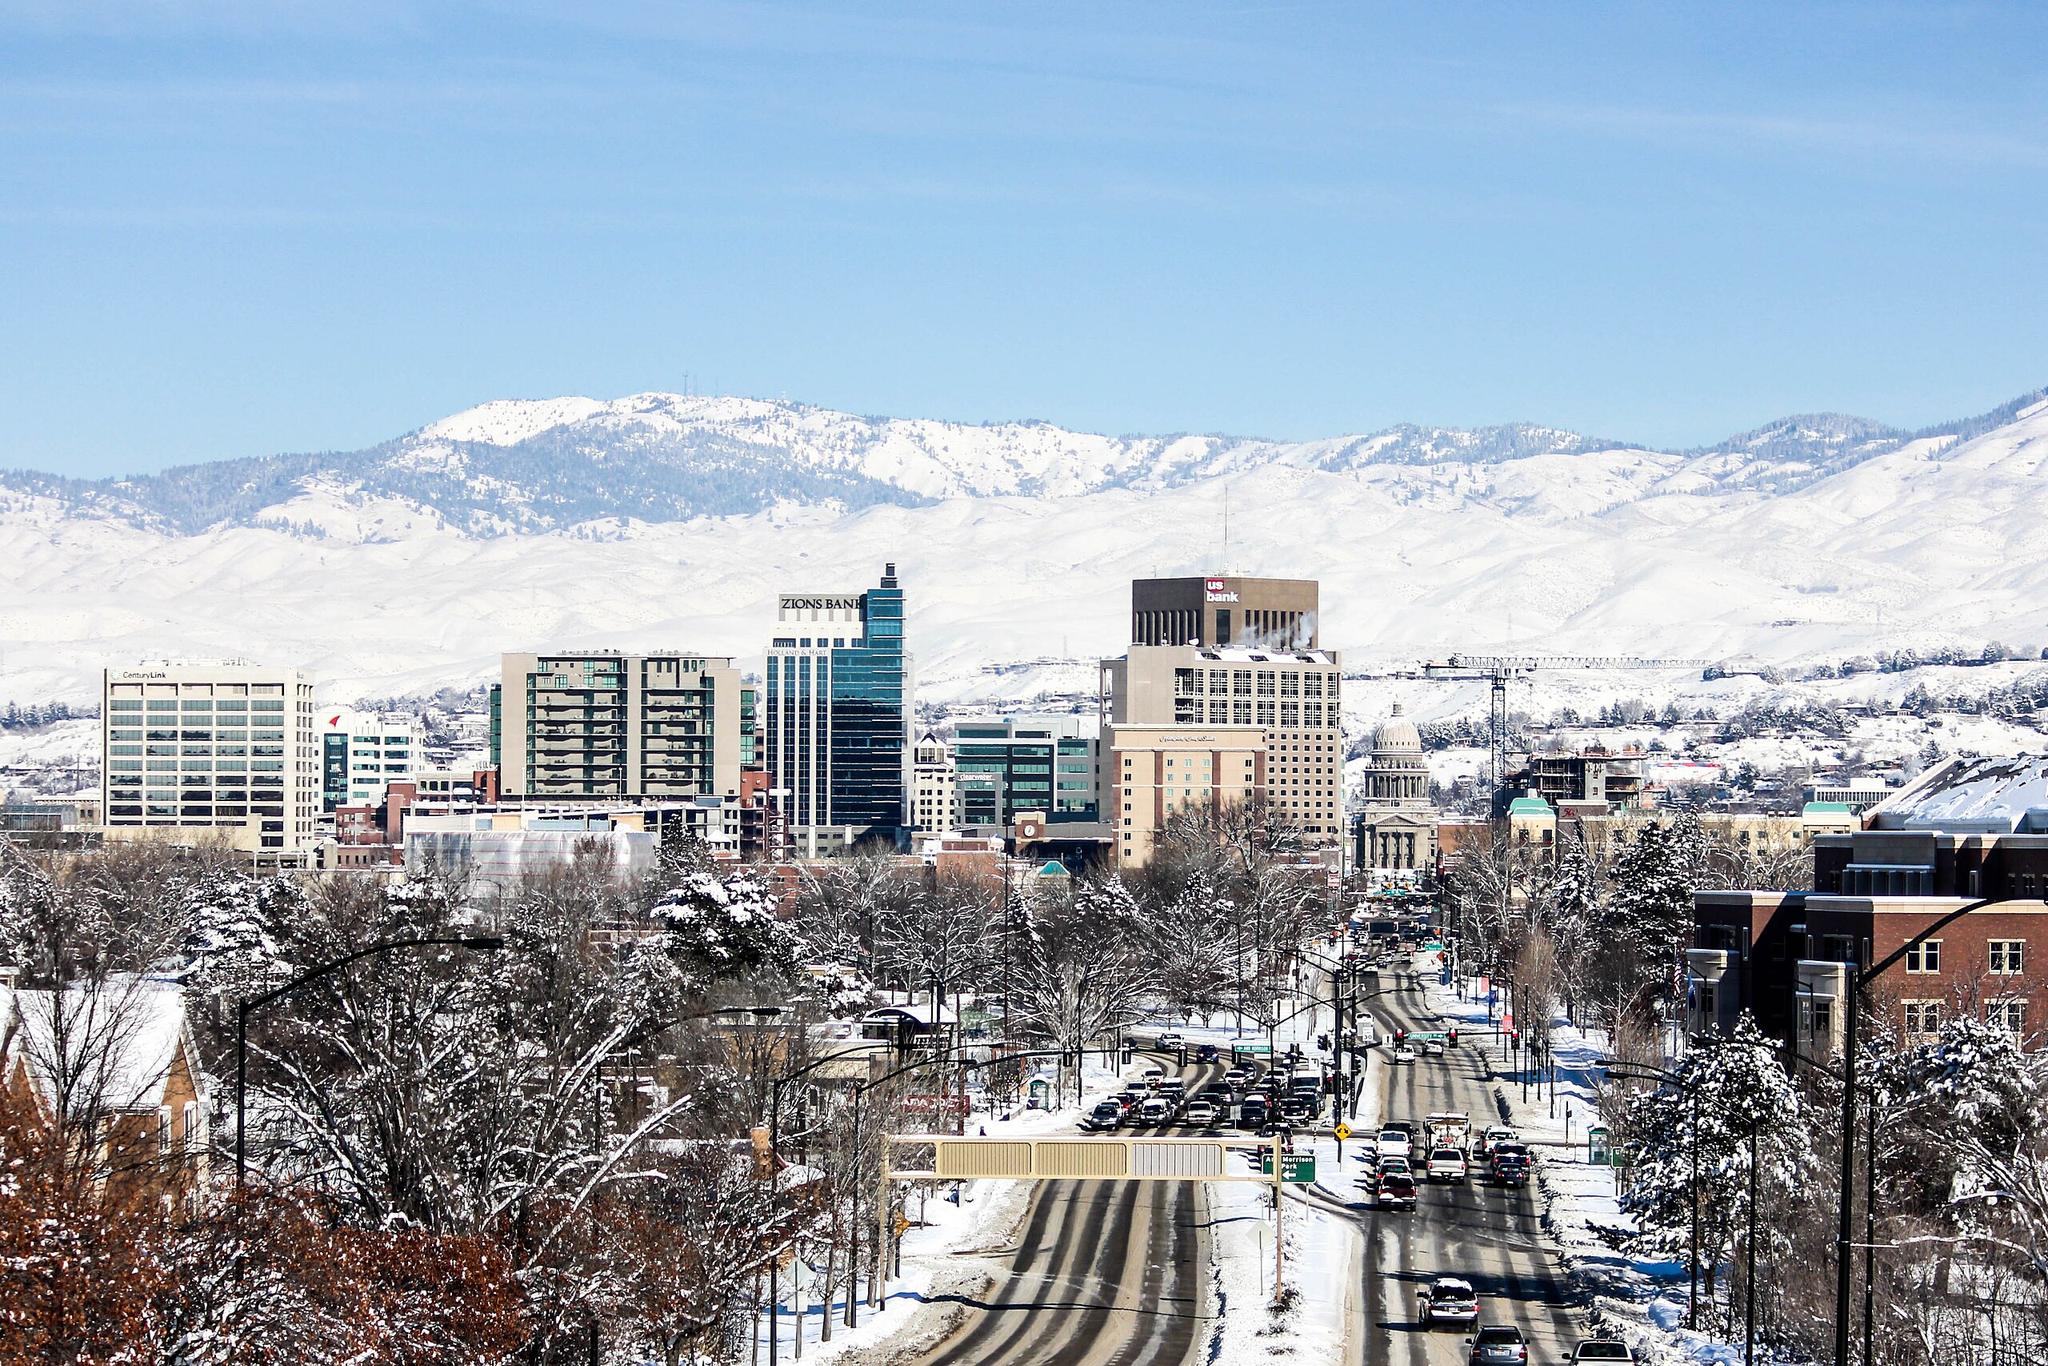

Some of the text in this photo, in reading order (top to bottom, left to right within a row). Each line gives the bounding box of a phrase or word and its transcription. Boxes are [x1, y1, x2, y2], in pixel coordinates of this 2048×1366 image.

[1206, 591, 1239, 602] bank
[781, 598, 823, 610] ZIONS
[123, 671, 167, 680] CenturyLink
